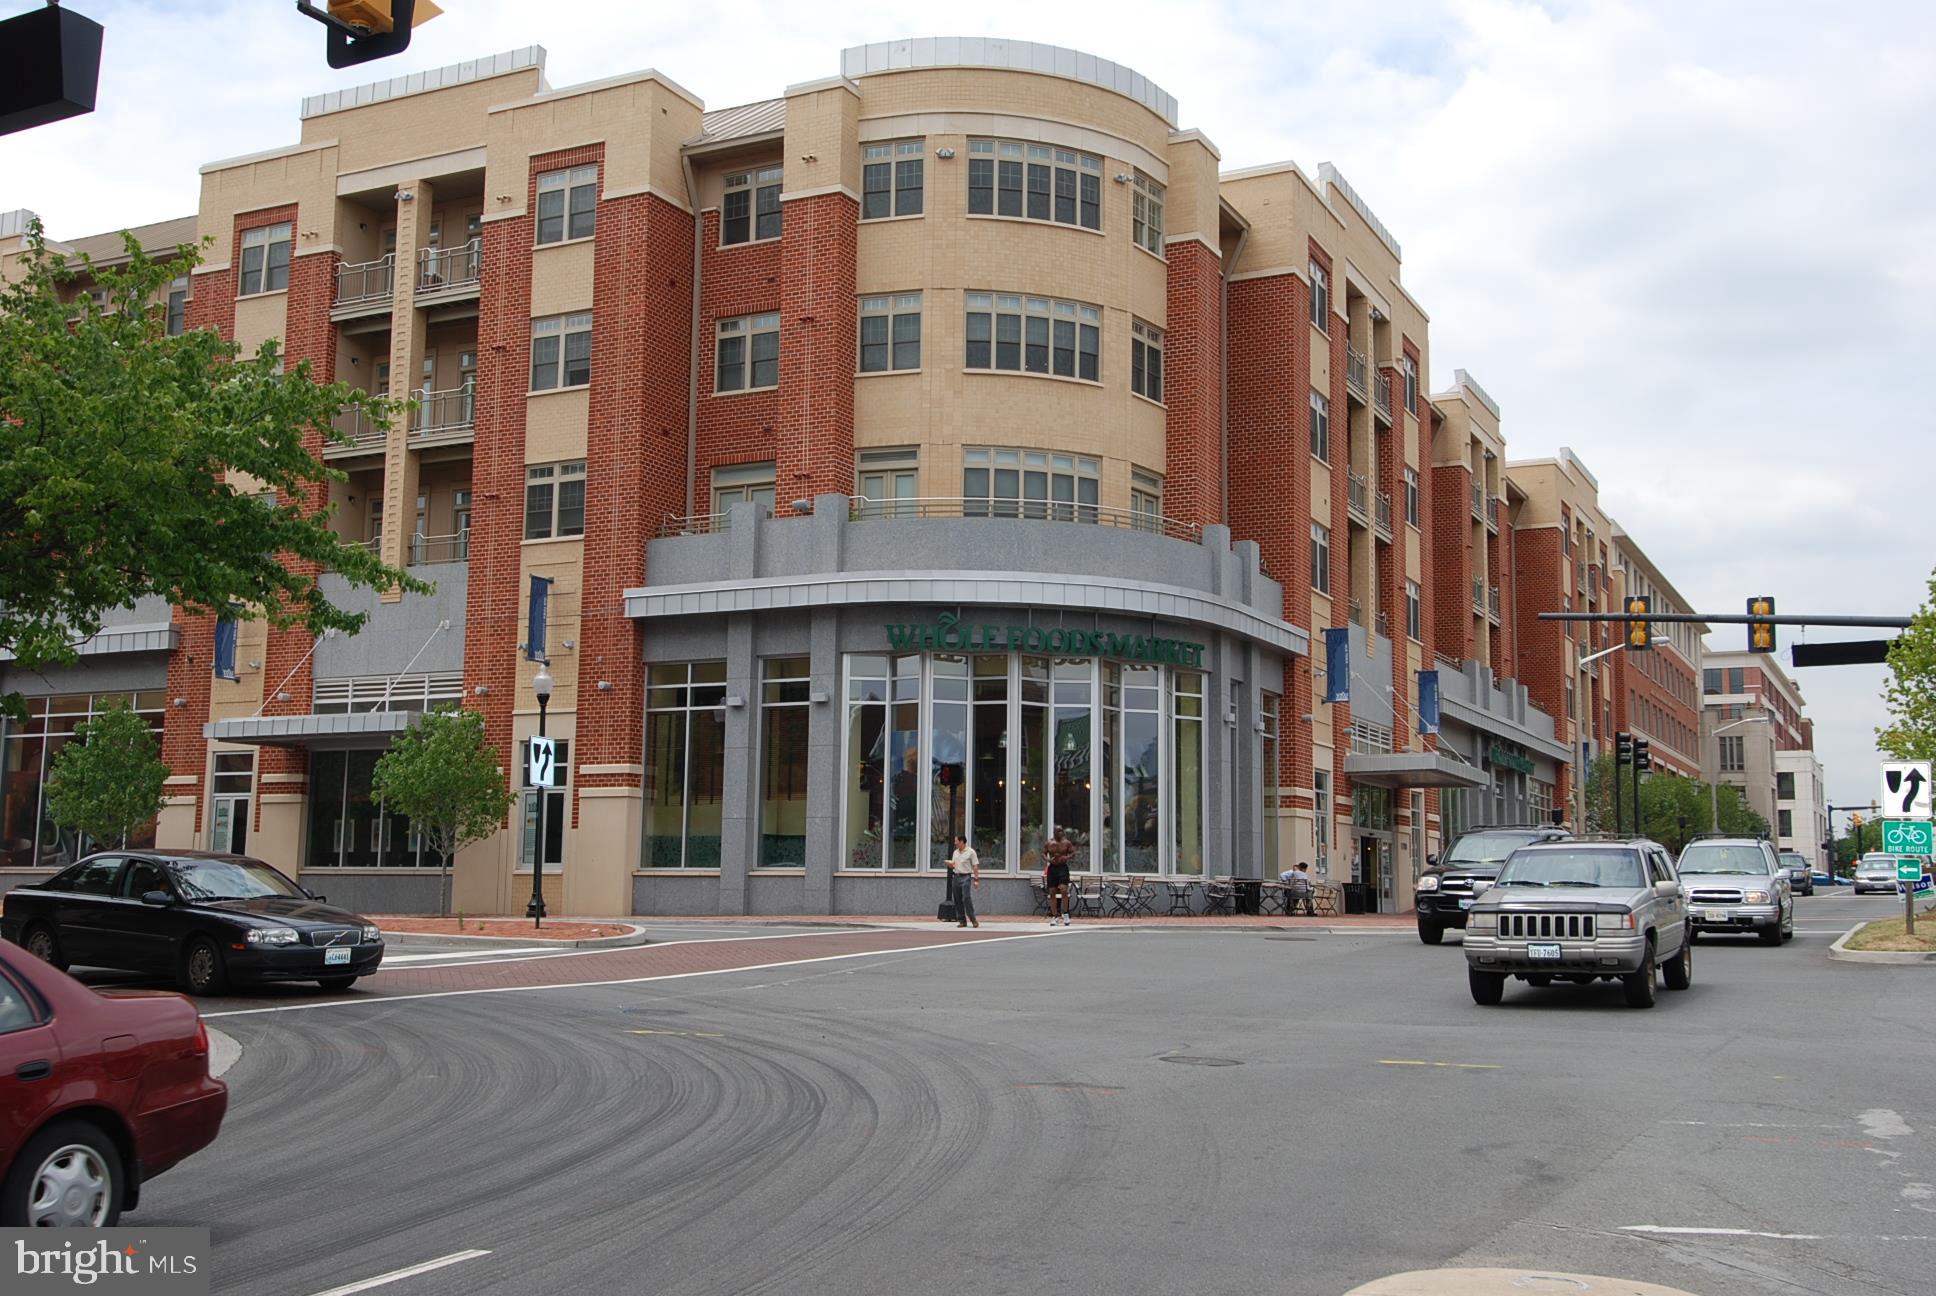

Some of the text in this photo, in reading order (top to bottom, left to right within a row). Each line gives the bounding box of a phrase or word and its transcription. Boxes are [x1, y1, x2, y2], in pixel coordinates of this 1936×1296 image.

[885, 614, 1206, 669] WHOLE FOODS MARKET
[1887, 845, 1929, 854] BIKE ROUTE
